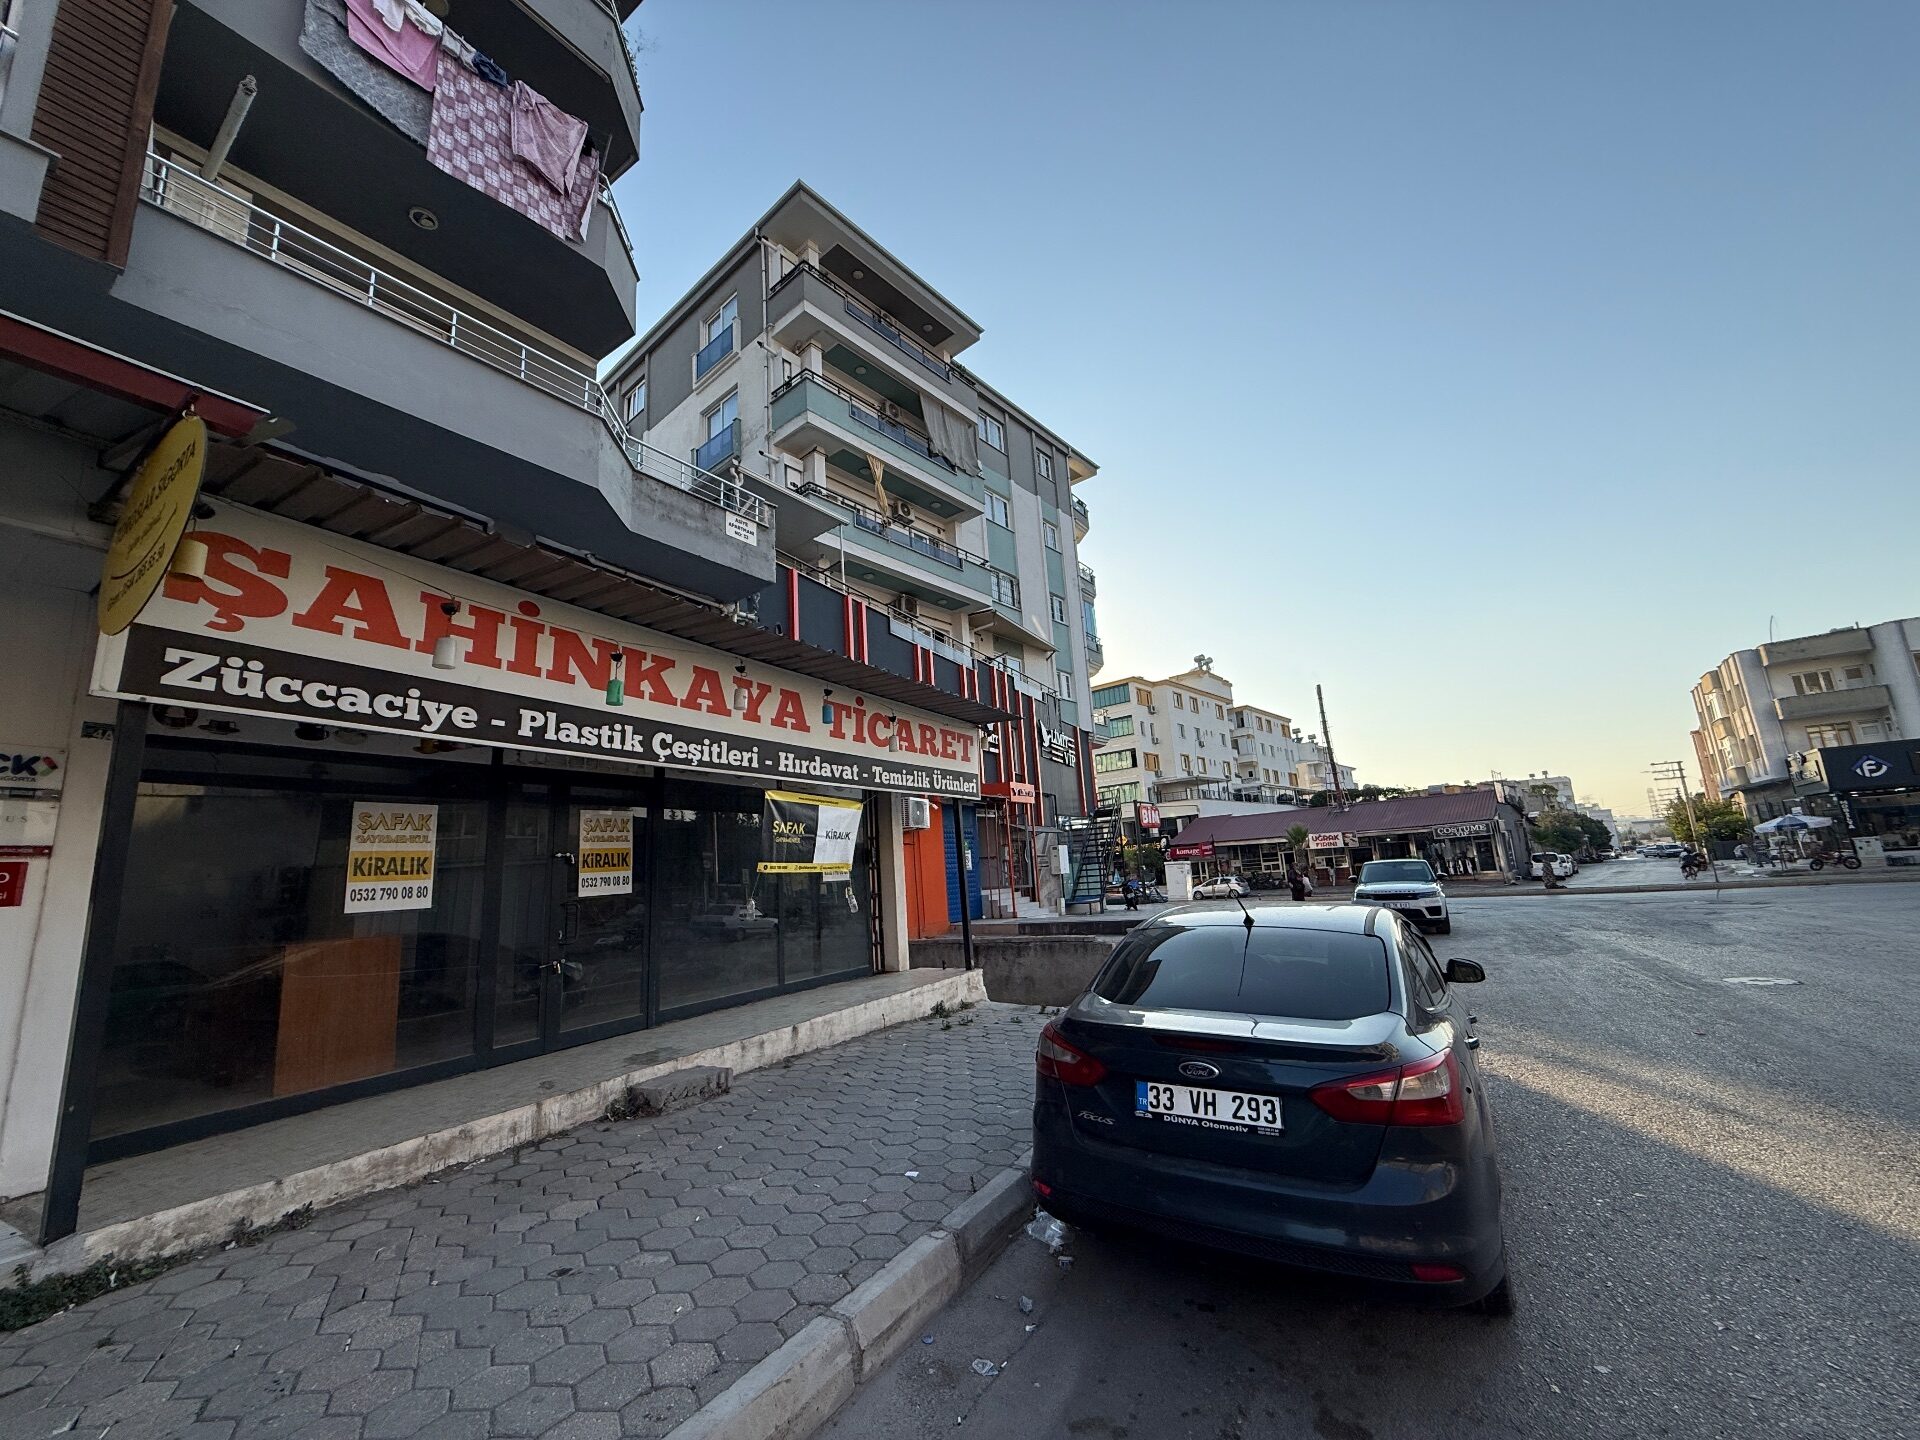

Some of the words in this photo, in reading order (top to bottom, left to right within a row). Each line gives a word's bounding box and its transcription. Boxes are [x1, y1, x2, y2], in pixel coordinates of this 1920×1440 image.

[163, 531, 810, 733] ŞAHİNKAYA
[829, 696, 974, 763] TİCARET
[160, 647, 478, 732] Züccaciye
[518, 708, 644, 753] Plastik
[653, 731, 759, 769] Çeşitleri
[778, 752, 858, 781] Hırdavat
[872, 766, 931, 789] Temizlik
[933, 769, 977, 793] Ürünleri
[357, 812, 433, 834] ŞAFAK
[582, 817, 630, 835] ŞAFAK
[1437, 823, 1487, 835] COSTUME
[1312, 833, 1340, 842] UĞRAK
[581, 877, 598, 888] 0532
[600, 876, 612, 887] 790
[613, 875, 621, 886] 08
[622, 875, 630, 886] 80
[350, 888, 377, 902] 0532
[380, 887, 399, 900] 790
[401, 886, 414, 899] 08
[416, 885, 429, 898] 80
[1186, 1064, 1208, 1076] Ford
[1138, 1097, 1148, 1106] TR
[1149, 1085, 1175, 1112] 33
[1188, 1089, 1217, 1117] VH
[1231, 1095, 1278, 1125] 293
[1163, 1114, 1200, 1127] DÜNYA
[1201, 1120, 1249, 1133] Otomotiv
